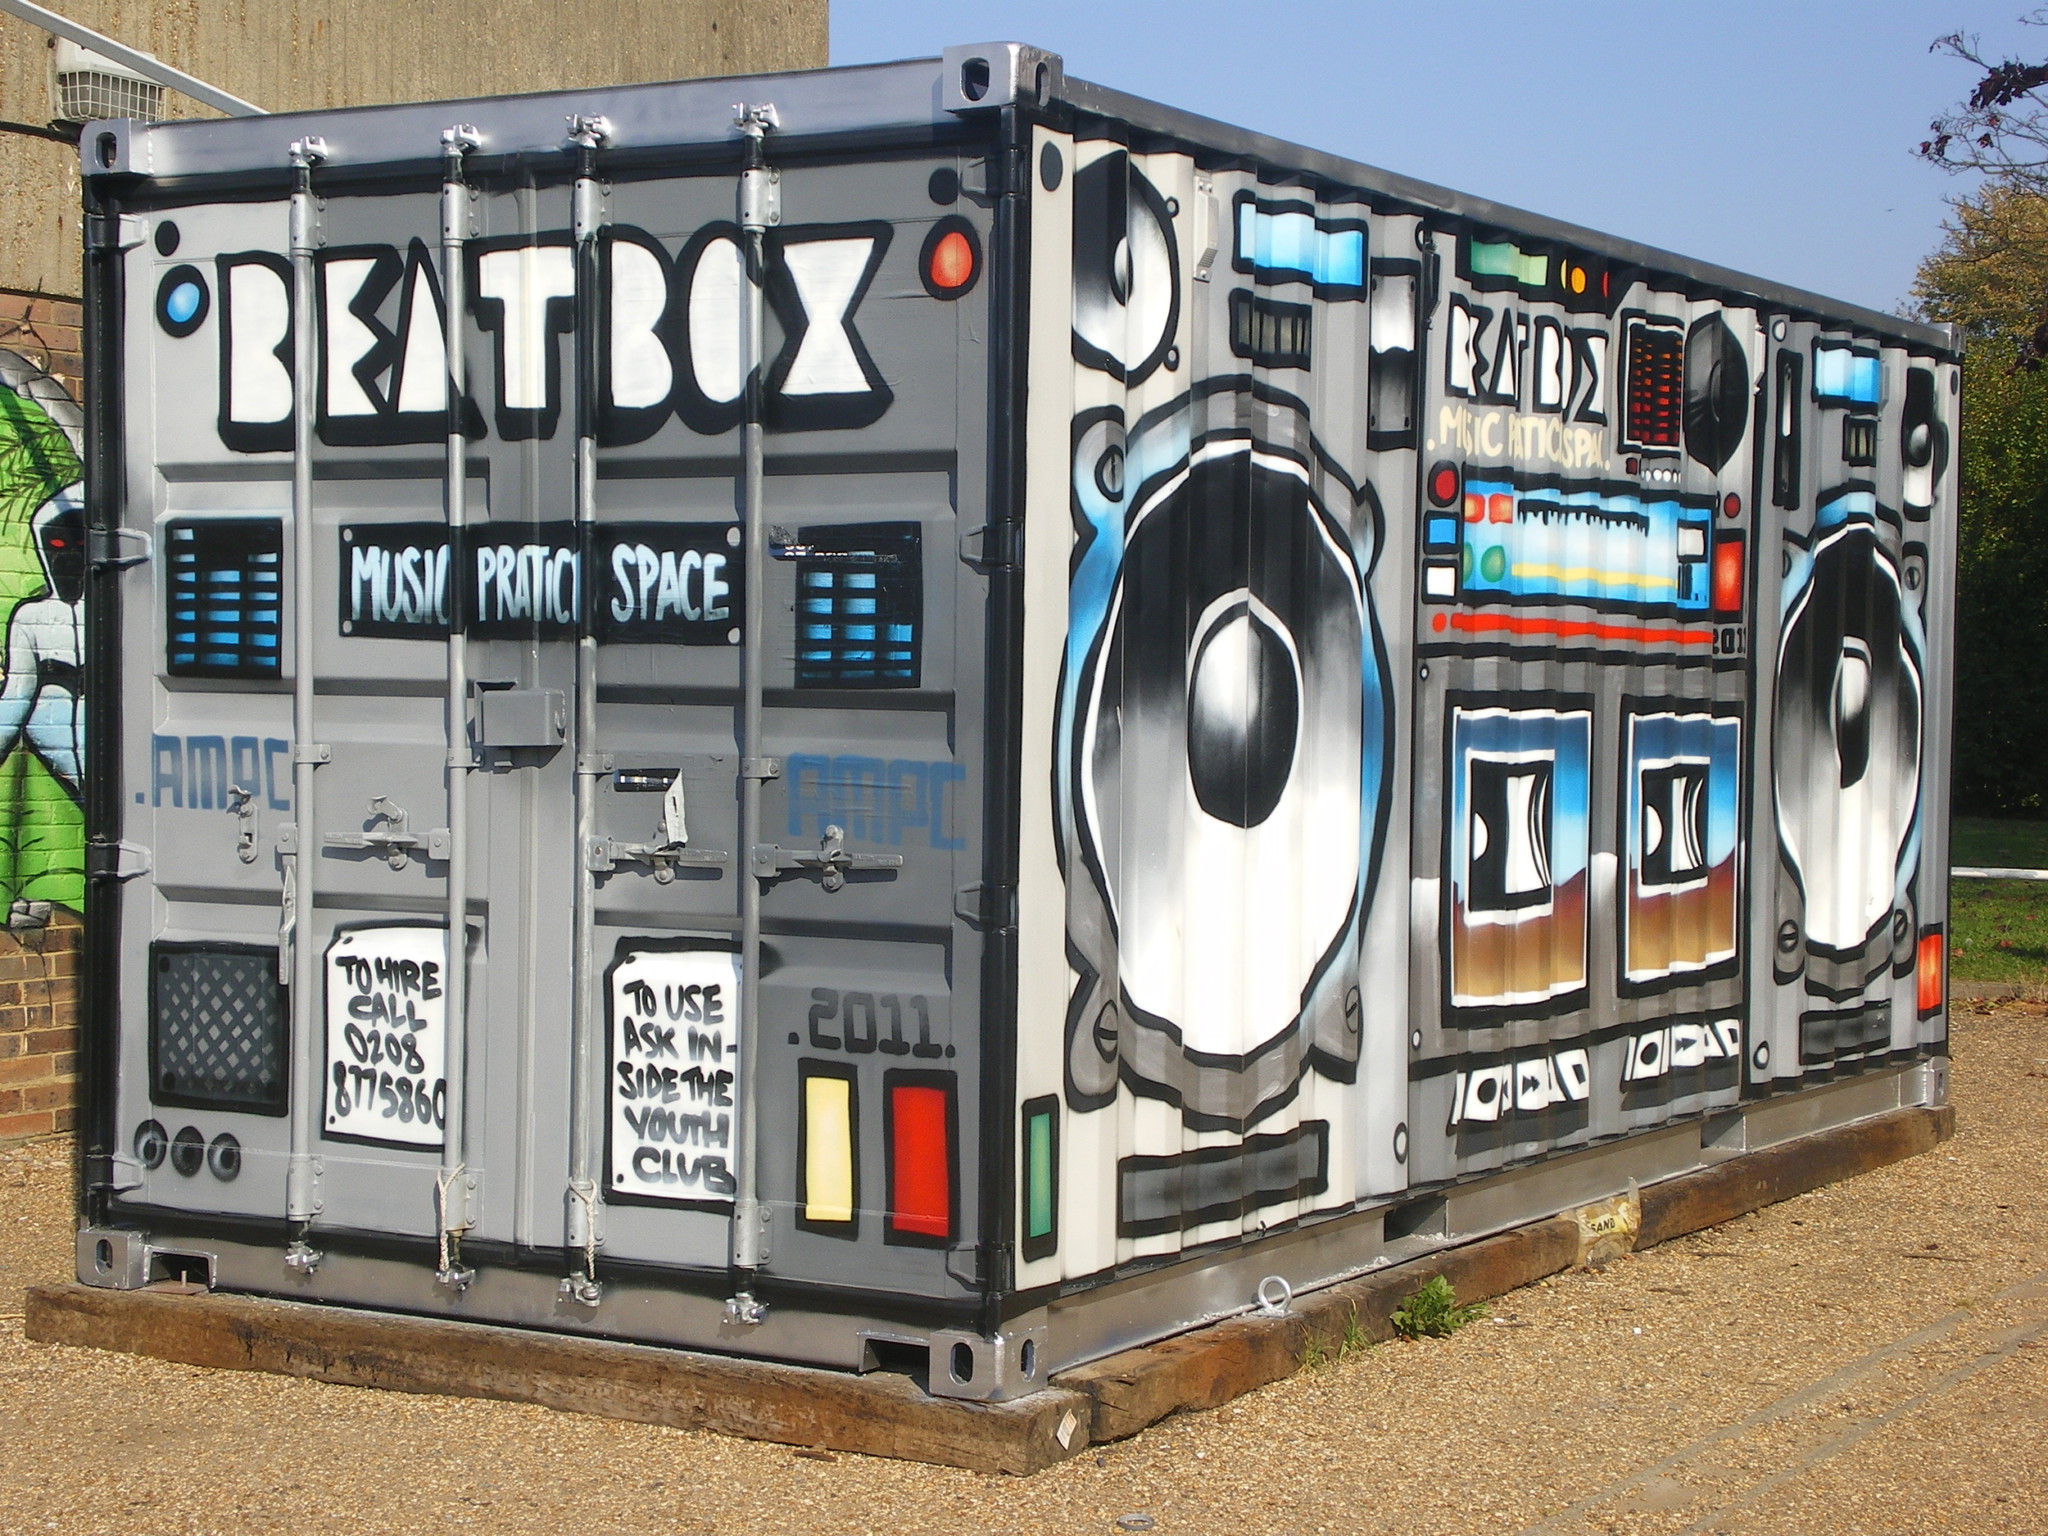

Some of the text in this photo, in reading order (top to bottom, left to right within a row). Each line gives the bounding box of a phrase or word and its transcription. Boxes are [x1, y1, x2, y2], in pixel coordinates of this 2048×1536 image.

[217, 221, 895, 451] BEATBOX
[1445, 291, 1609, 427] BEABX
[476, 543, 581, 625] PRATIC
[611, 542, 730, 623] SPACE
[335, 955, 442, 1001] TO HIRE
[347, 992, 427, 1032] CALL
[623, 979, 724, 1026] TO USE
[344, 1023, 424, 1074] 0208
[623, 1015, 679, 1060] ASK
[333, 1060, 447, 1130] 8775860
[616, 1060, 733, 1107] SIDE THE
[624, 1105, 729, 1149] YOUTH
[632, 1146, 737, 1194] CLUB
[1590, 1217, 1616, 1232] SAND
